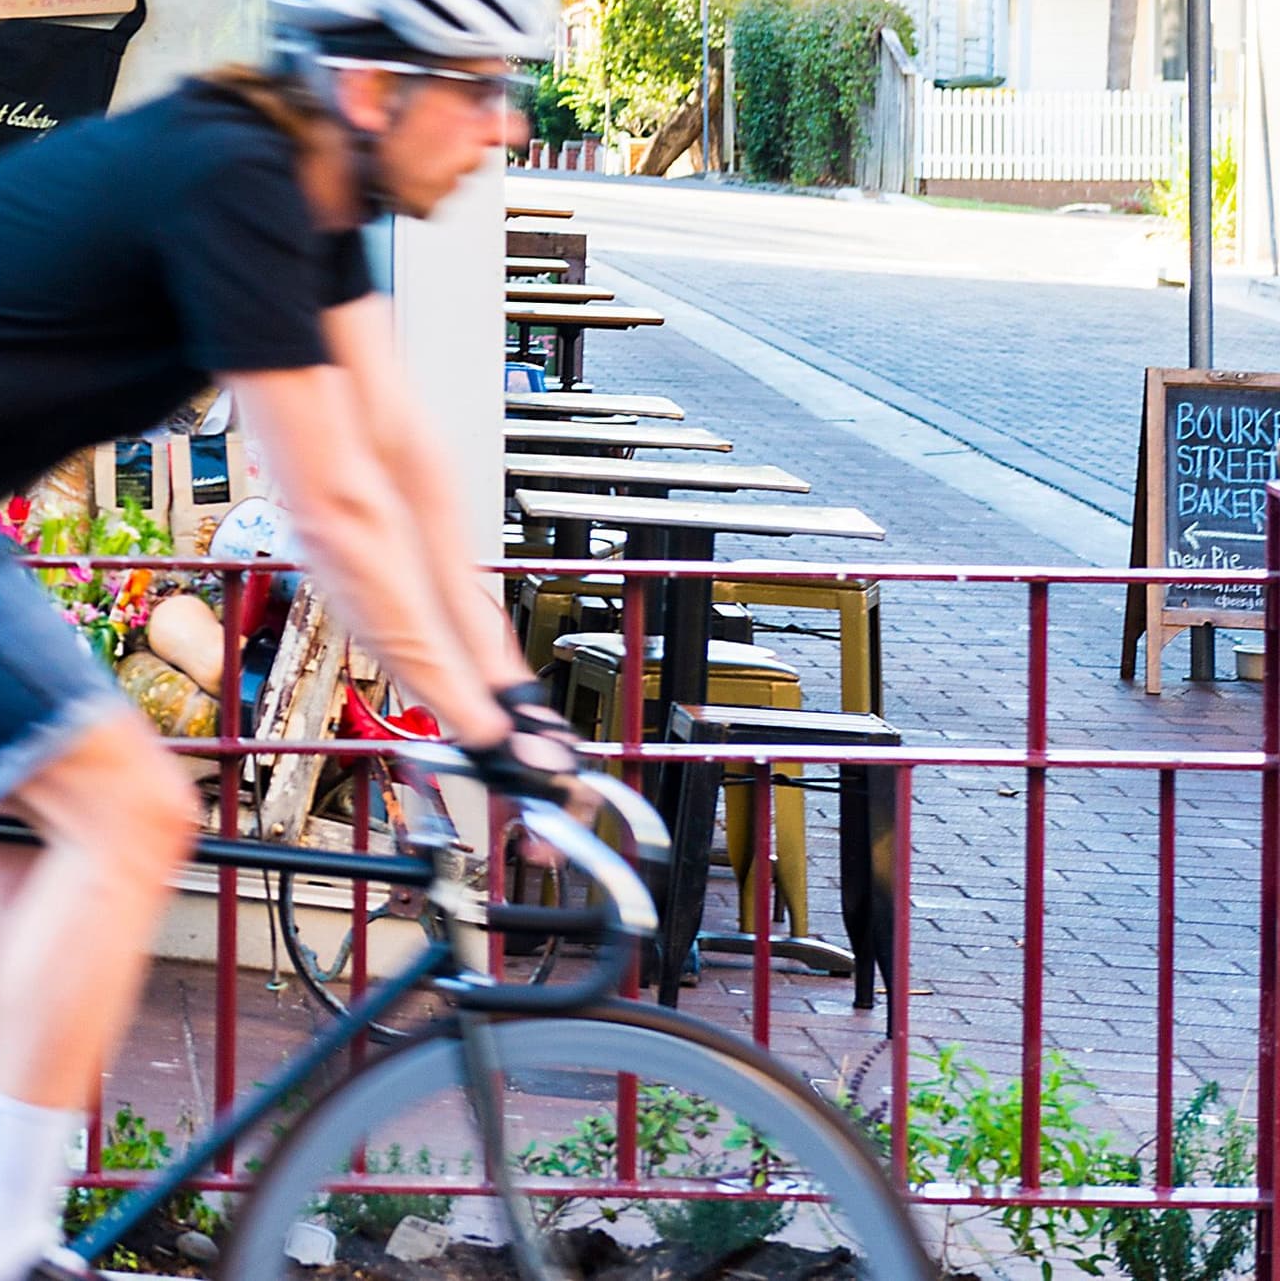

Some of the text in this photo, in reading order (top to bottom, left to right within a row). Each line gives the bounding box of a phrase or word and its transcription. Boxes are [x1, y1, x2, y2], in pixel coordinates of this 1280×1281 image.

[1176, 445, 1278, 483] STREET
[1178, 482, 1268, 526] BAKER
[1168, 546, 1207, 569] new
